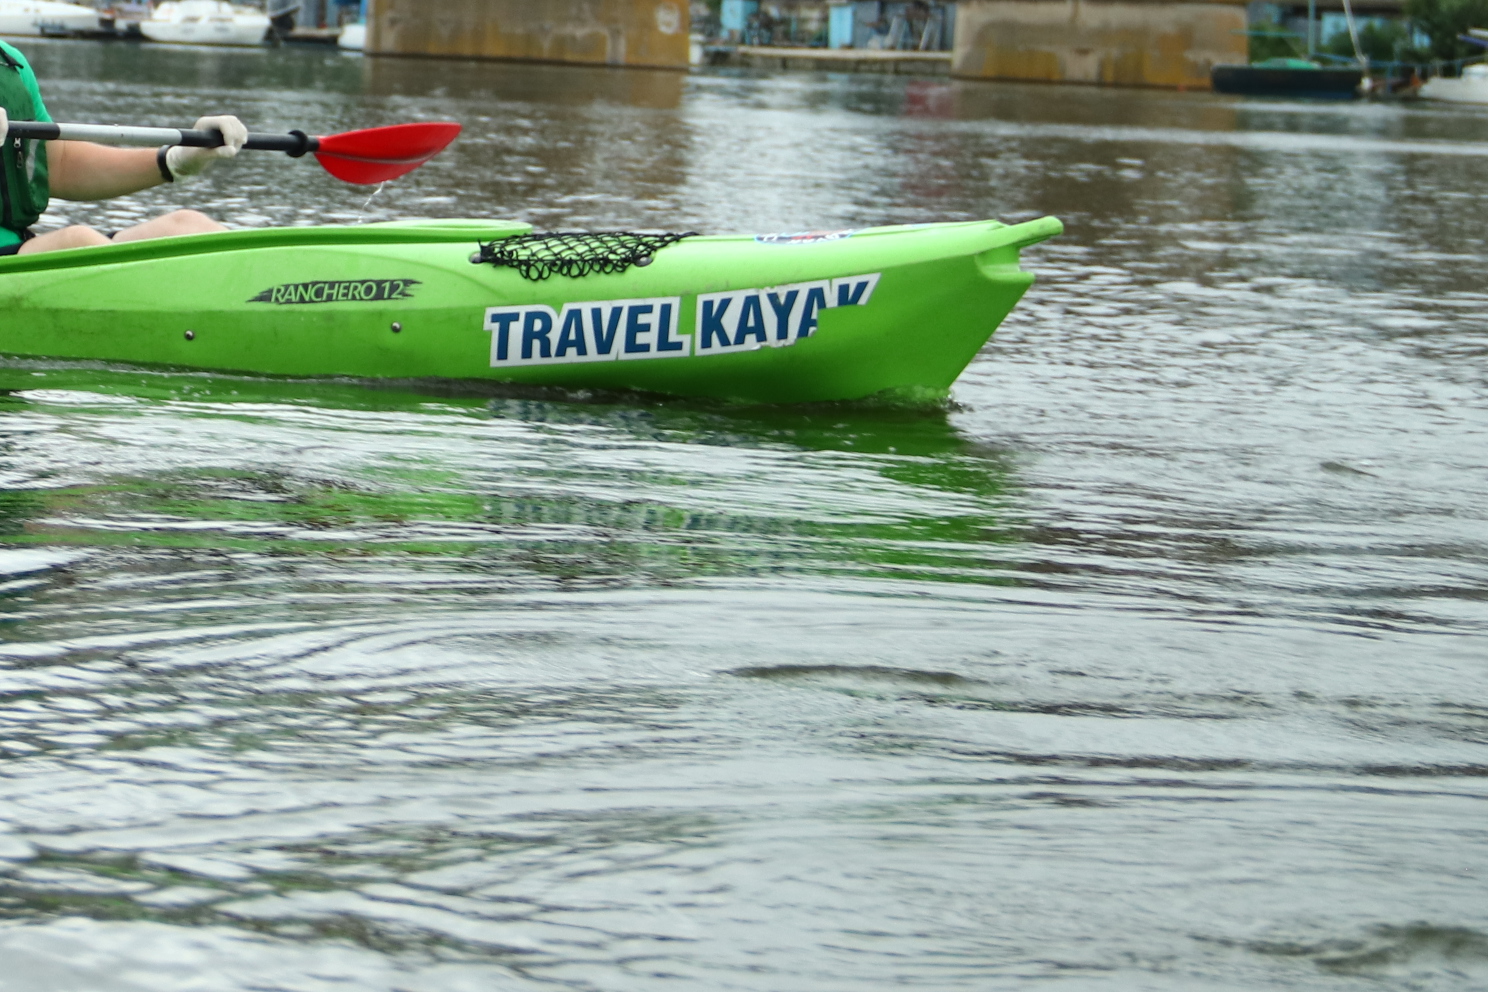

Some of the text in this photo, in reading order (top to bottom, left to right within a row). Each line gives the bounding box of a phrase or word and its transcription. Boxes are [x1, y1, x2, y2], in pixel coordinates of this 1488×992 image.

[271, 280, 406, 302] RANCHERO 12
[491, 302, 684, 361] TRAVEL
